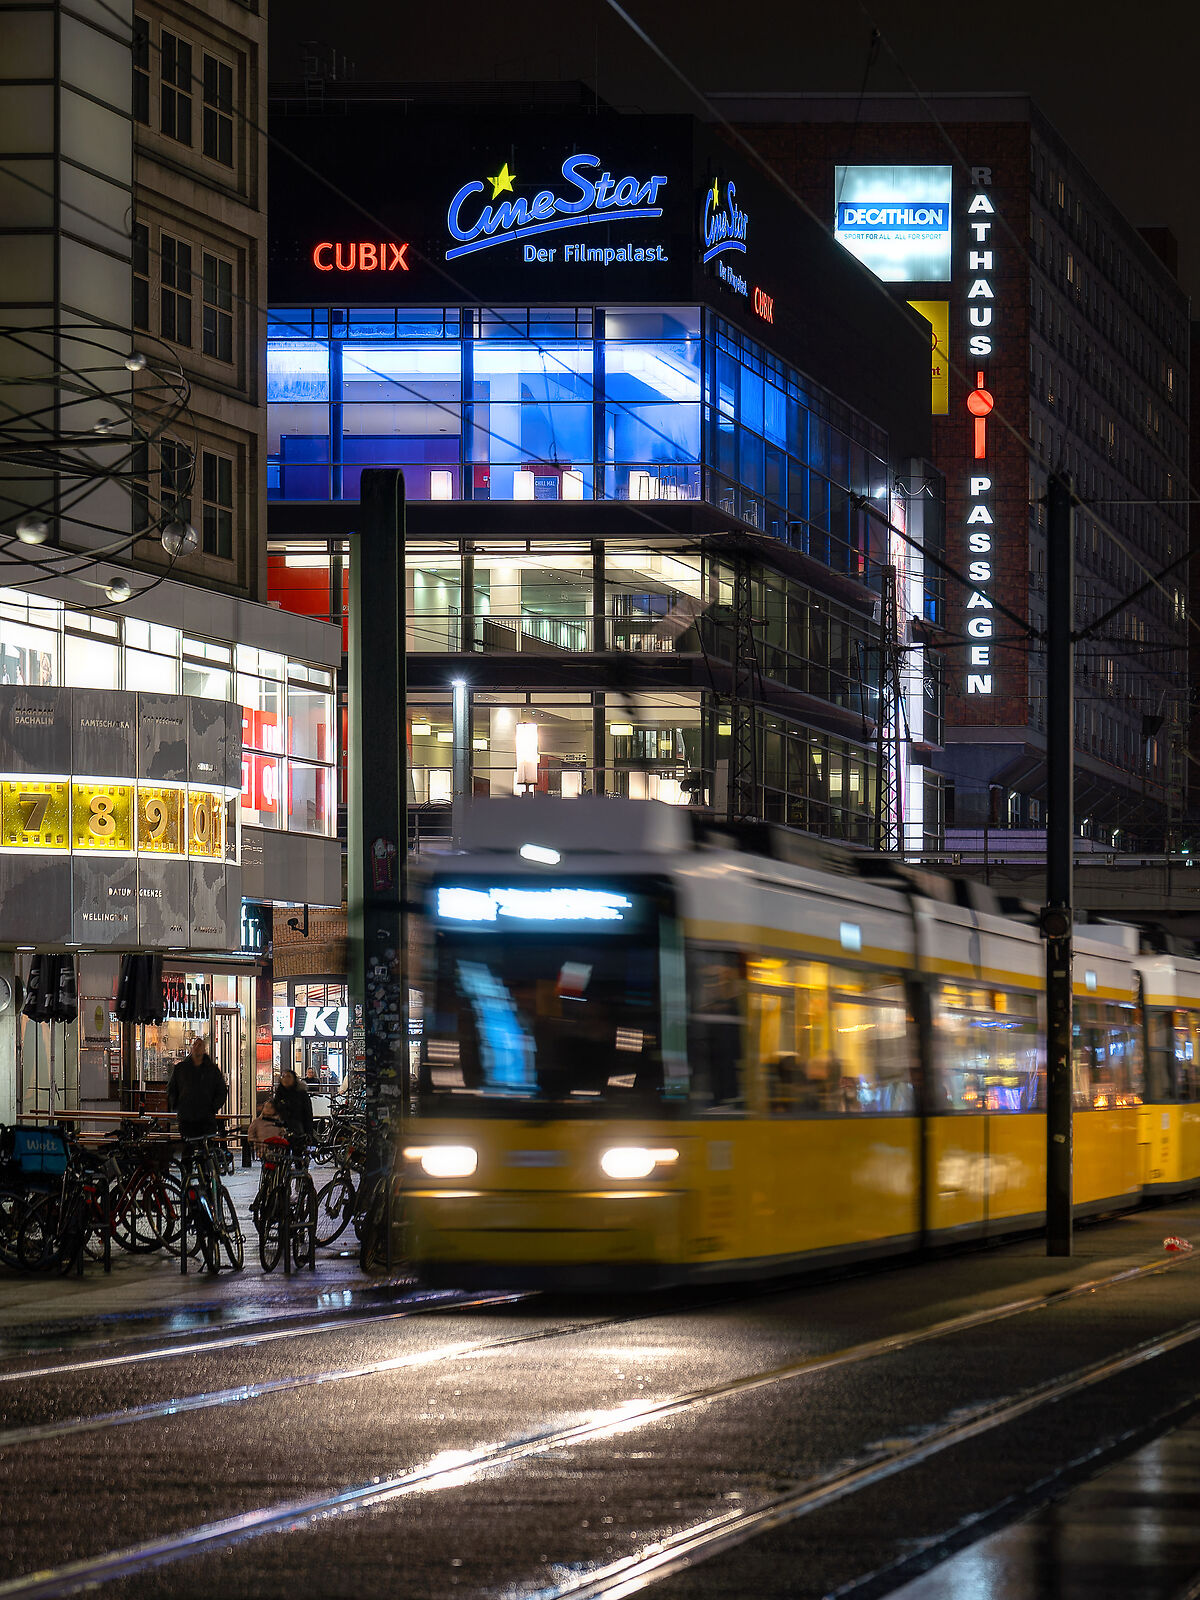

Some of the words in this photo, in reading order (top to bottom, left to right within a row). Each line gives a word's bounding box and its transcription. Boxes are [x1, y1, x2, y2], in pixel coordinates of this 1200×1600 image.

[448, 154, 667, 241] CineStar
[843, 208, 943, 225] DECATHLON
[312, 242, 410, 272] CUBIX
[523, 244, 557, 263] Der
[564, 243, 669, 266] Filmpalast.
[967, 166, 995, 355] RATHAUS
[754, 286, 774, 325] CUBIX
[966, 477, 994, 694] PASSAGEN
[15, 716, 54, 725] SACHALIN
[19, 792, 52, 832] 7
[88, 795, 116, 837] 8
[145, 798, 168, 839] 9
[26, 1139, 58, 1152] Wolt
